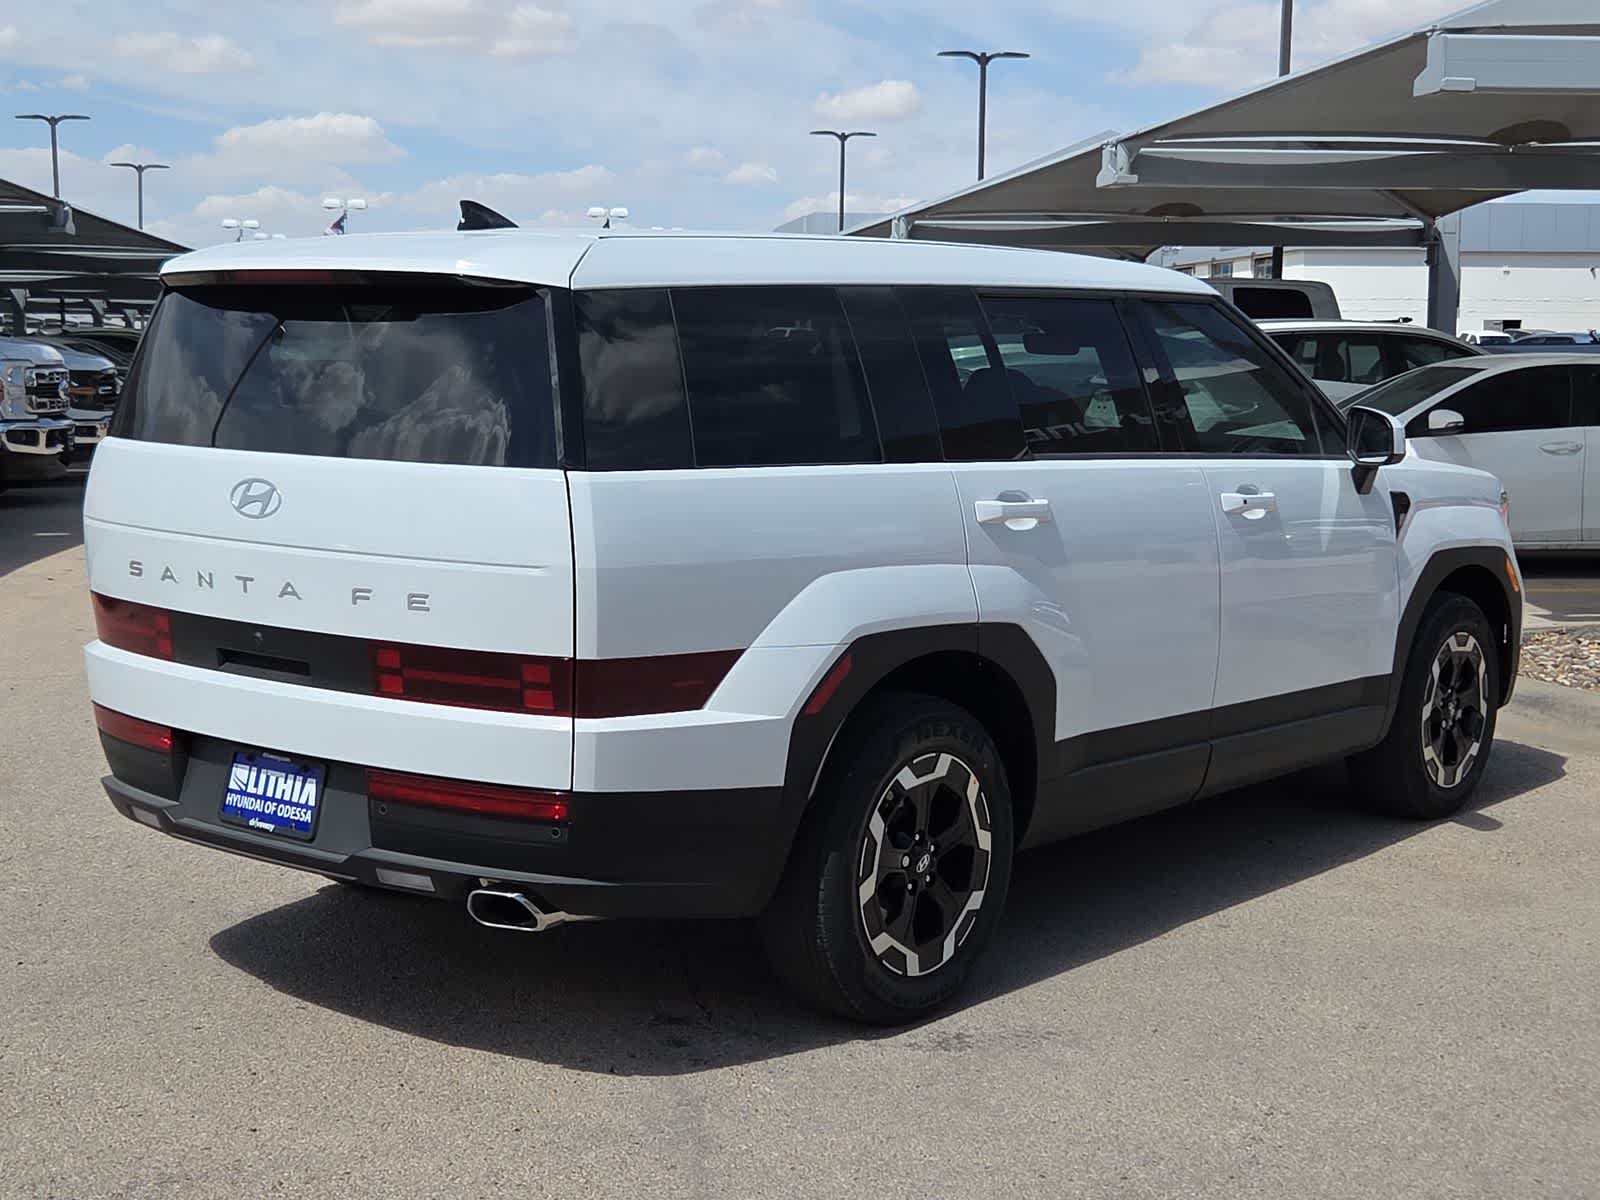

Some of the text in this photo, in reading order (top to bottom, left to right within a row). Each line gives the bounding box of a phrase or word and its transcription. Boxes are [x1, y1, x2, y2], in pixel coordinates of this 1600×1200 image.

[129, 560, 430, 612] SANTA FE
[246, 766, 317, 807] LITHIA
[225, 792, 312, 823] HYUNDAI OF ODESSA
